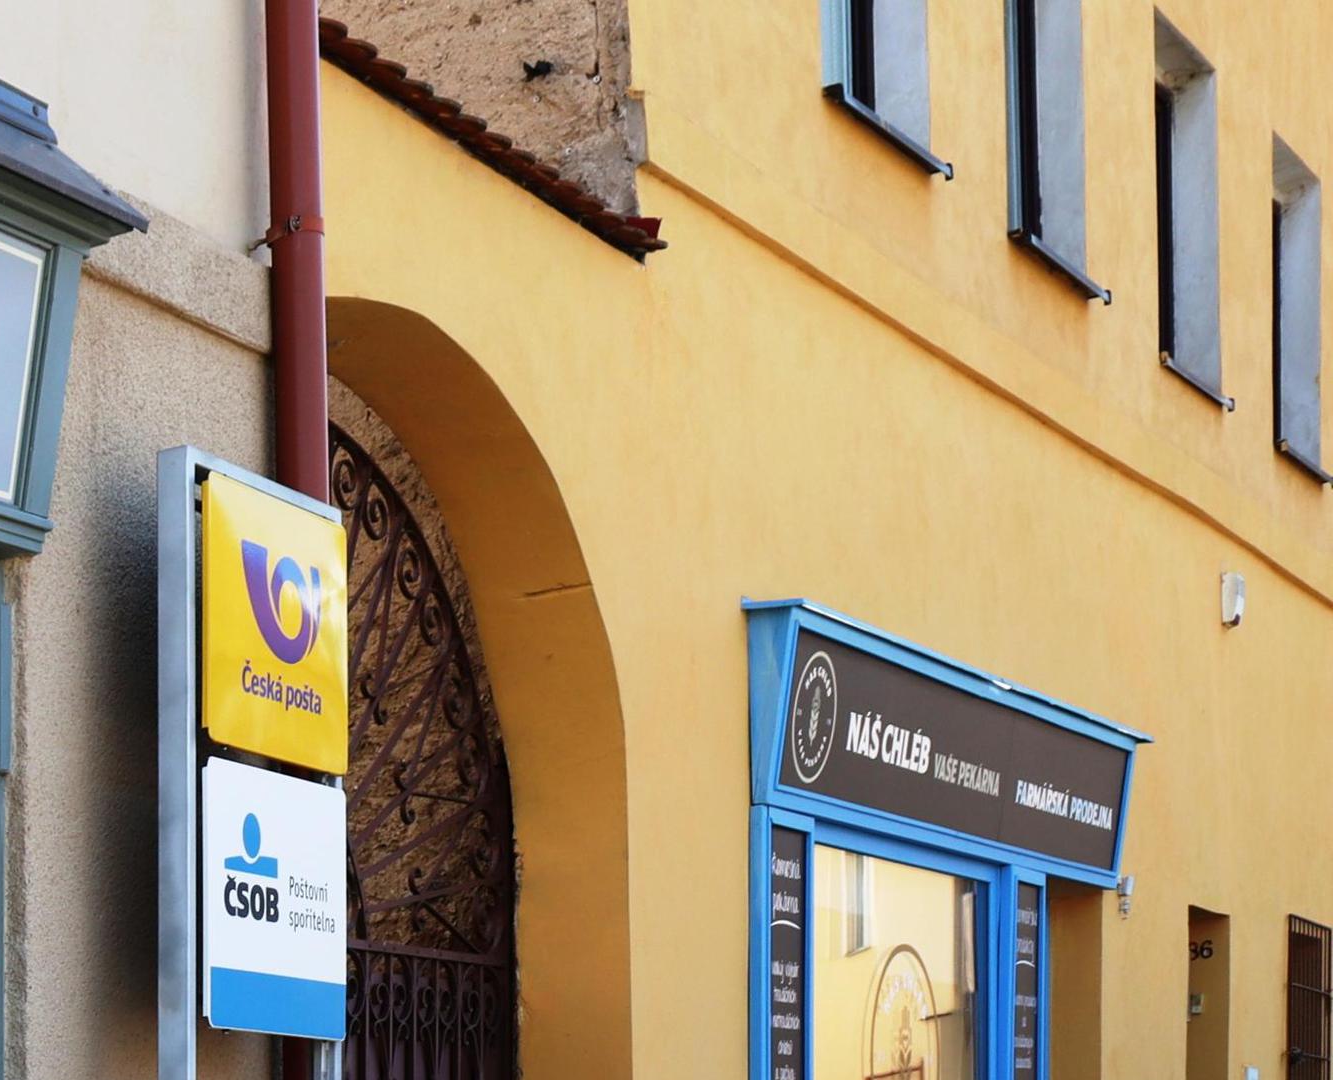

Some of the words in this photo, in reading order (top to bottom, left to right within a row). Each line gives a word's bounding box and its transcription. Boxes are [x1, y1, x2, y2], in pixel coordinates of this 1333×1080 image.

[242, 659, 283, 703] Česká
[285, 684, 322, 715] pošta
[845, 711, 882, 760] NÁŠ
[881, 724, 931, 774] CHLÉB
[934, 752, 958, 784] VAŠE
[957, 761, 1001, 797] PEKÁRNA
[1015, 779, 1070, 818] FARMÁŘSKÁ
[1069, 796, 1113, 830] PRODEJNA
[224, 874, 279, 923] ČSOB
[288, 876, 328, 903] Poštovní
[289, 908, 336, 933] spořitelna
